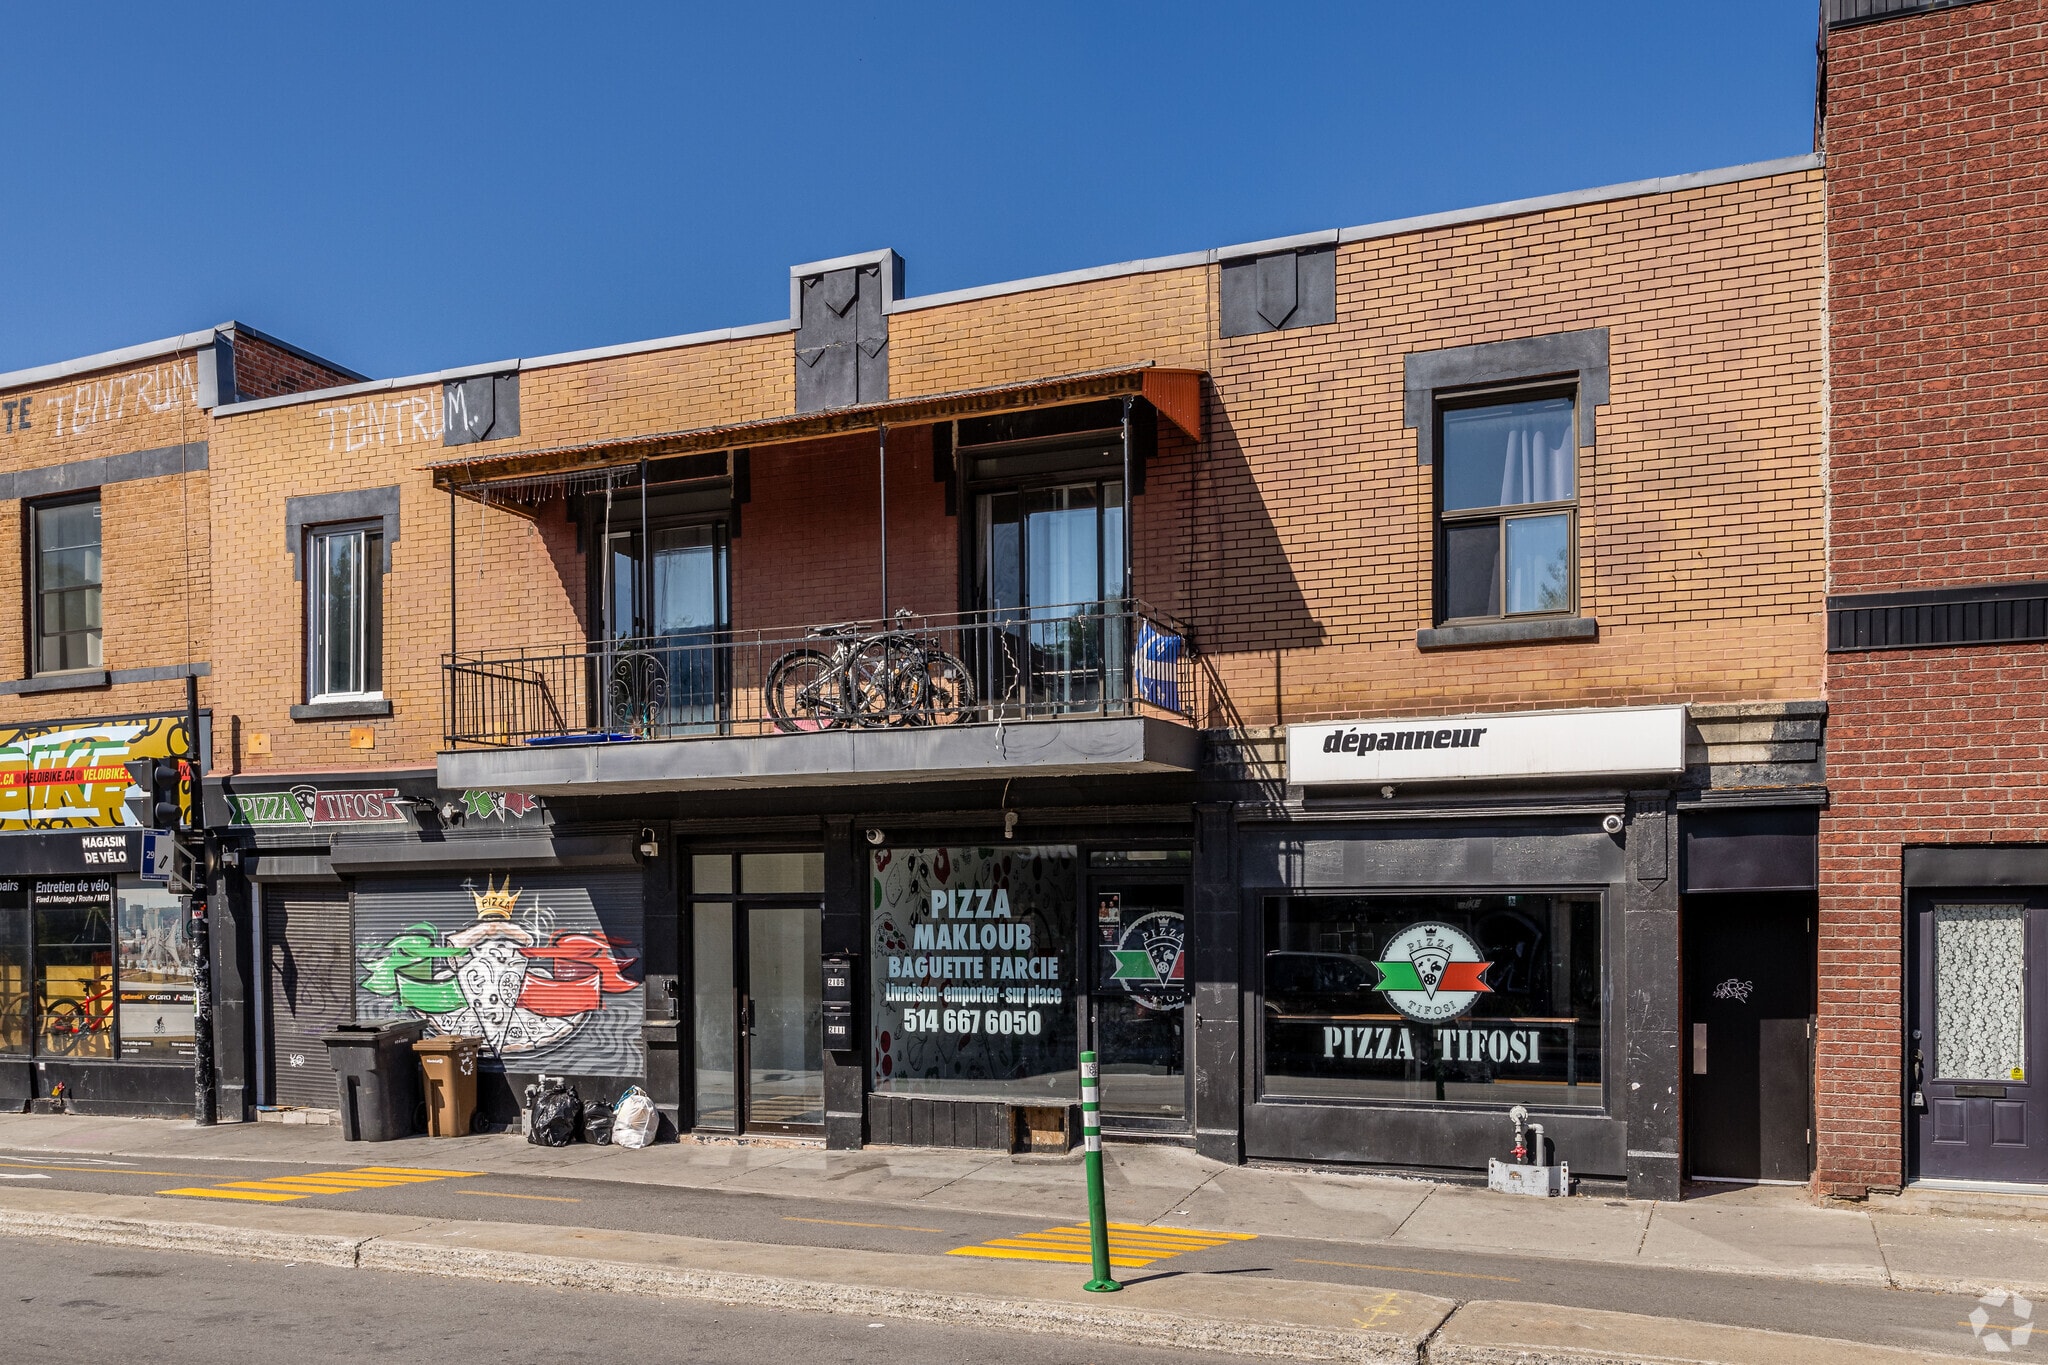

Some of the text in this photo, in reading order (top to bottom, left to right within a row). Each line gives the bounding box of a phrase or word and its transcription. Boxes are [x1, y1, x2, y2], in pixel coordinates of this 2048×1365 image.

[1323, 727, 1487, 756] dépanneur
[23, 770, 75, 784] VELOIBIKE.CA
[237, 793, 388, 820] PIZZA TIFOSI
[82, 835, 126, 848] MAGASIN
[84, 849, 127, 864] DE VÉLO
[146, 851, 155, 859] 29
[35, 879, 110, 893] Entretien de vélo
[53, 895, 75, 904] Montage
[97, 894, 110, 902] MTB
[481, 897, 510, 909] PIZZA
[931, 889, 1012, 919] PIZZA
[913, 923, 1032, 951] MAKLOUB
[1406, 937, 1455, 952] PIZZA
[888, 956, 1059, 980] BAGUETTE FARCIE
[1028, 985, 1062, 1008] place
[1407, 1000, 1456, 1015] TIFOSI
[904, 1008, 1041, 1035] 514 667 6050
[1323, 1026, 1540, 1064] PIZZA TIFOSI
